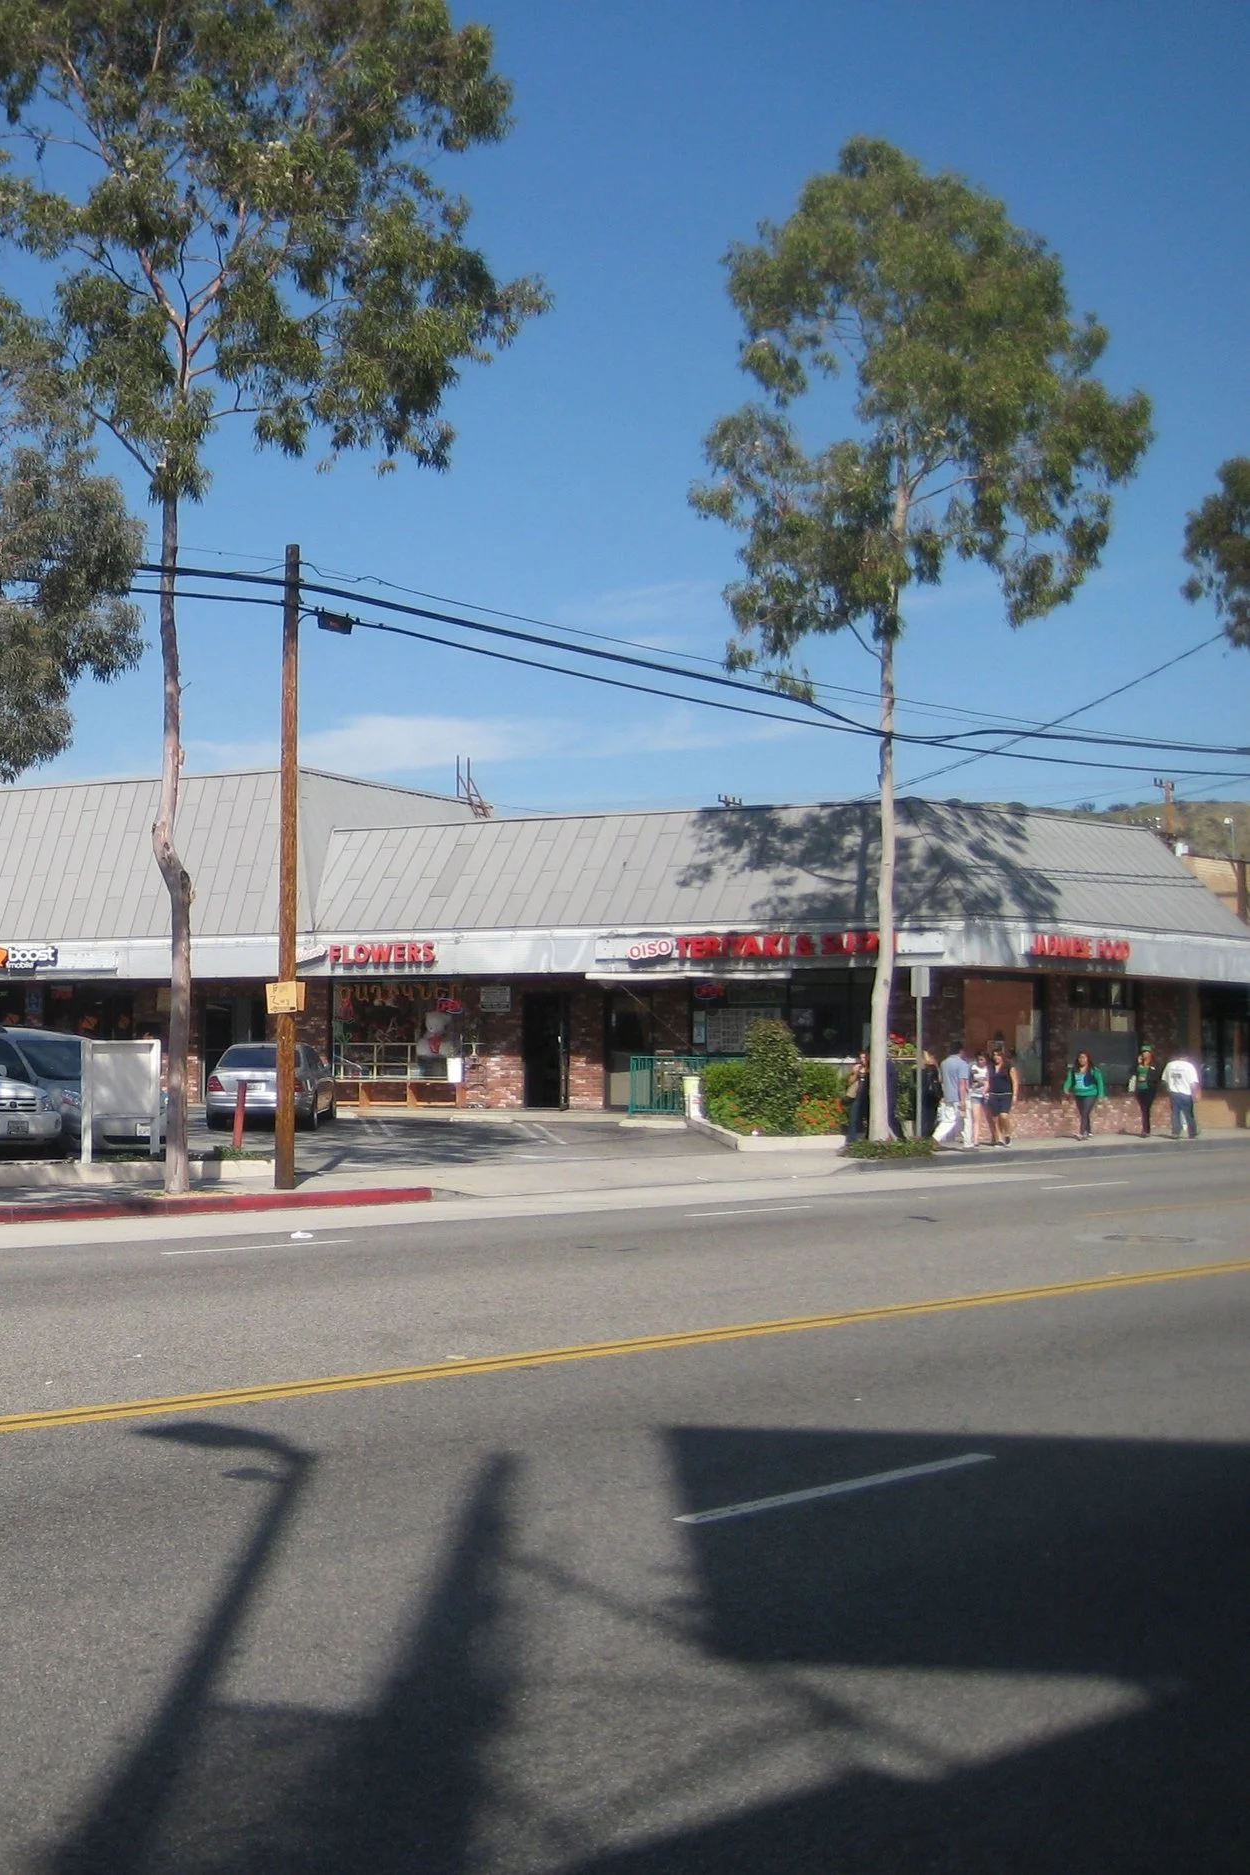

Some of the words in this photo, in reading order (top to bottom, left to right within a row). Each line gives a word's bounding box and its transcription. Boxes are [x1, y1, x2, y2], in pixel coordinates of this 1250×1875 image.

[8, 946, 55, 962] boost
[328, 941, 436, 964] FLOWERS
[629, 940, 671, 959] OISO
[676, 934, 791, 958] TERIYAKI
[1032, 932, 1093, 959] JAPANESE
[1096, 939, 1130, 960] FOOD
[10, 961, 35, 969] mobile
